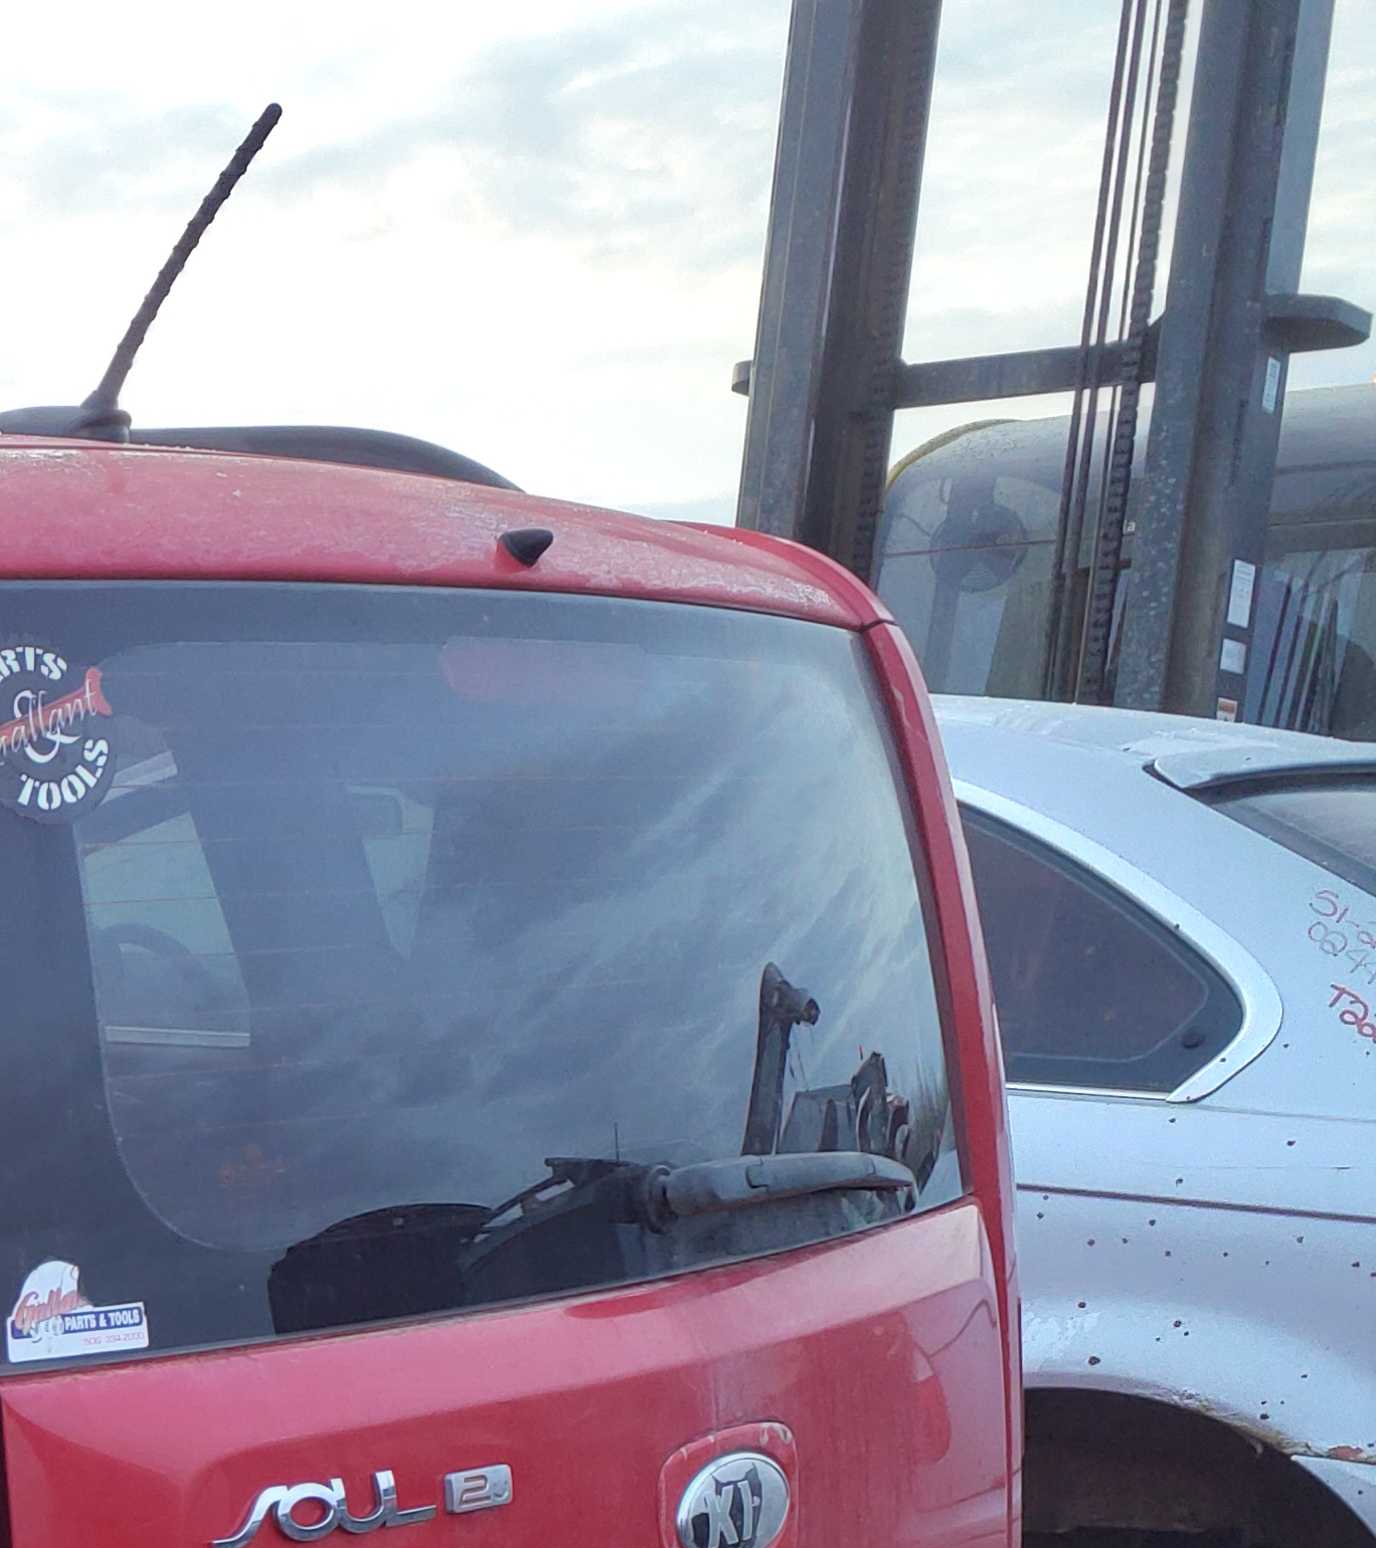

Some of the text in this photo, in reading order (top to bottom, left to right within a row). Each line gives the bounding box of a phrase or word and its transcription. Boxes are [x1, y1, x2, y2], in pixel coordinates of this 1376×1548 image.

[16, 738, 109, 811] TOOLS
[64, 1313, 97, 1331] PARTS
[108, 1309, 141, 1327] TOOLS
